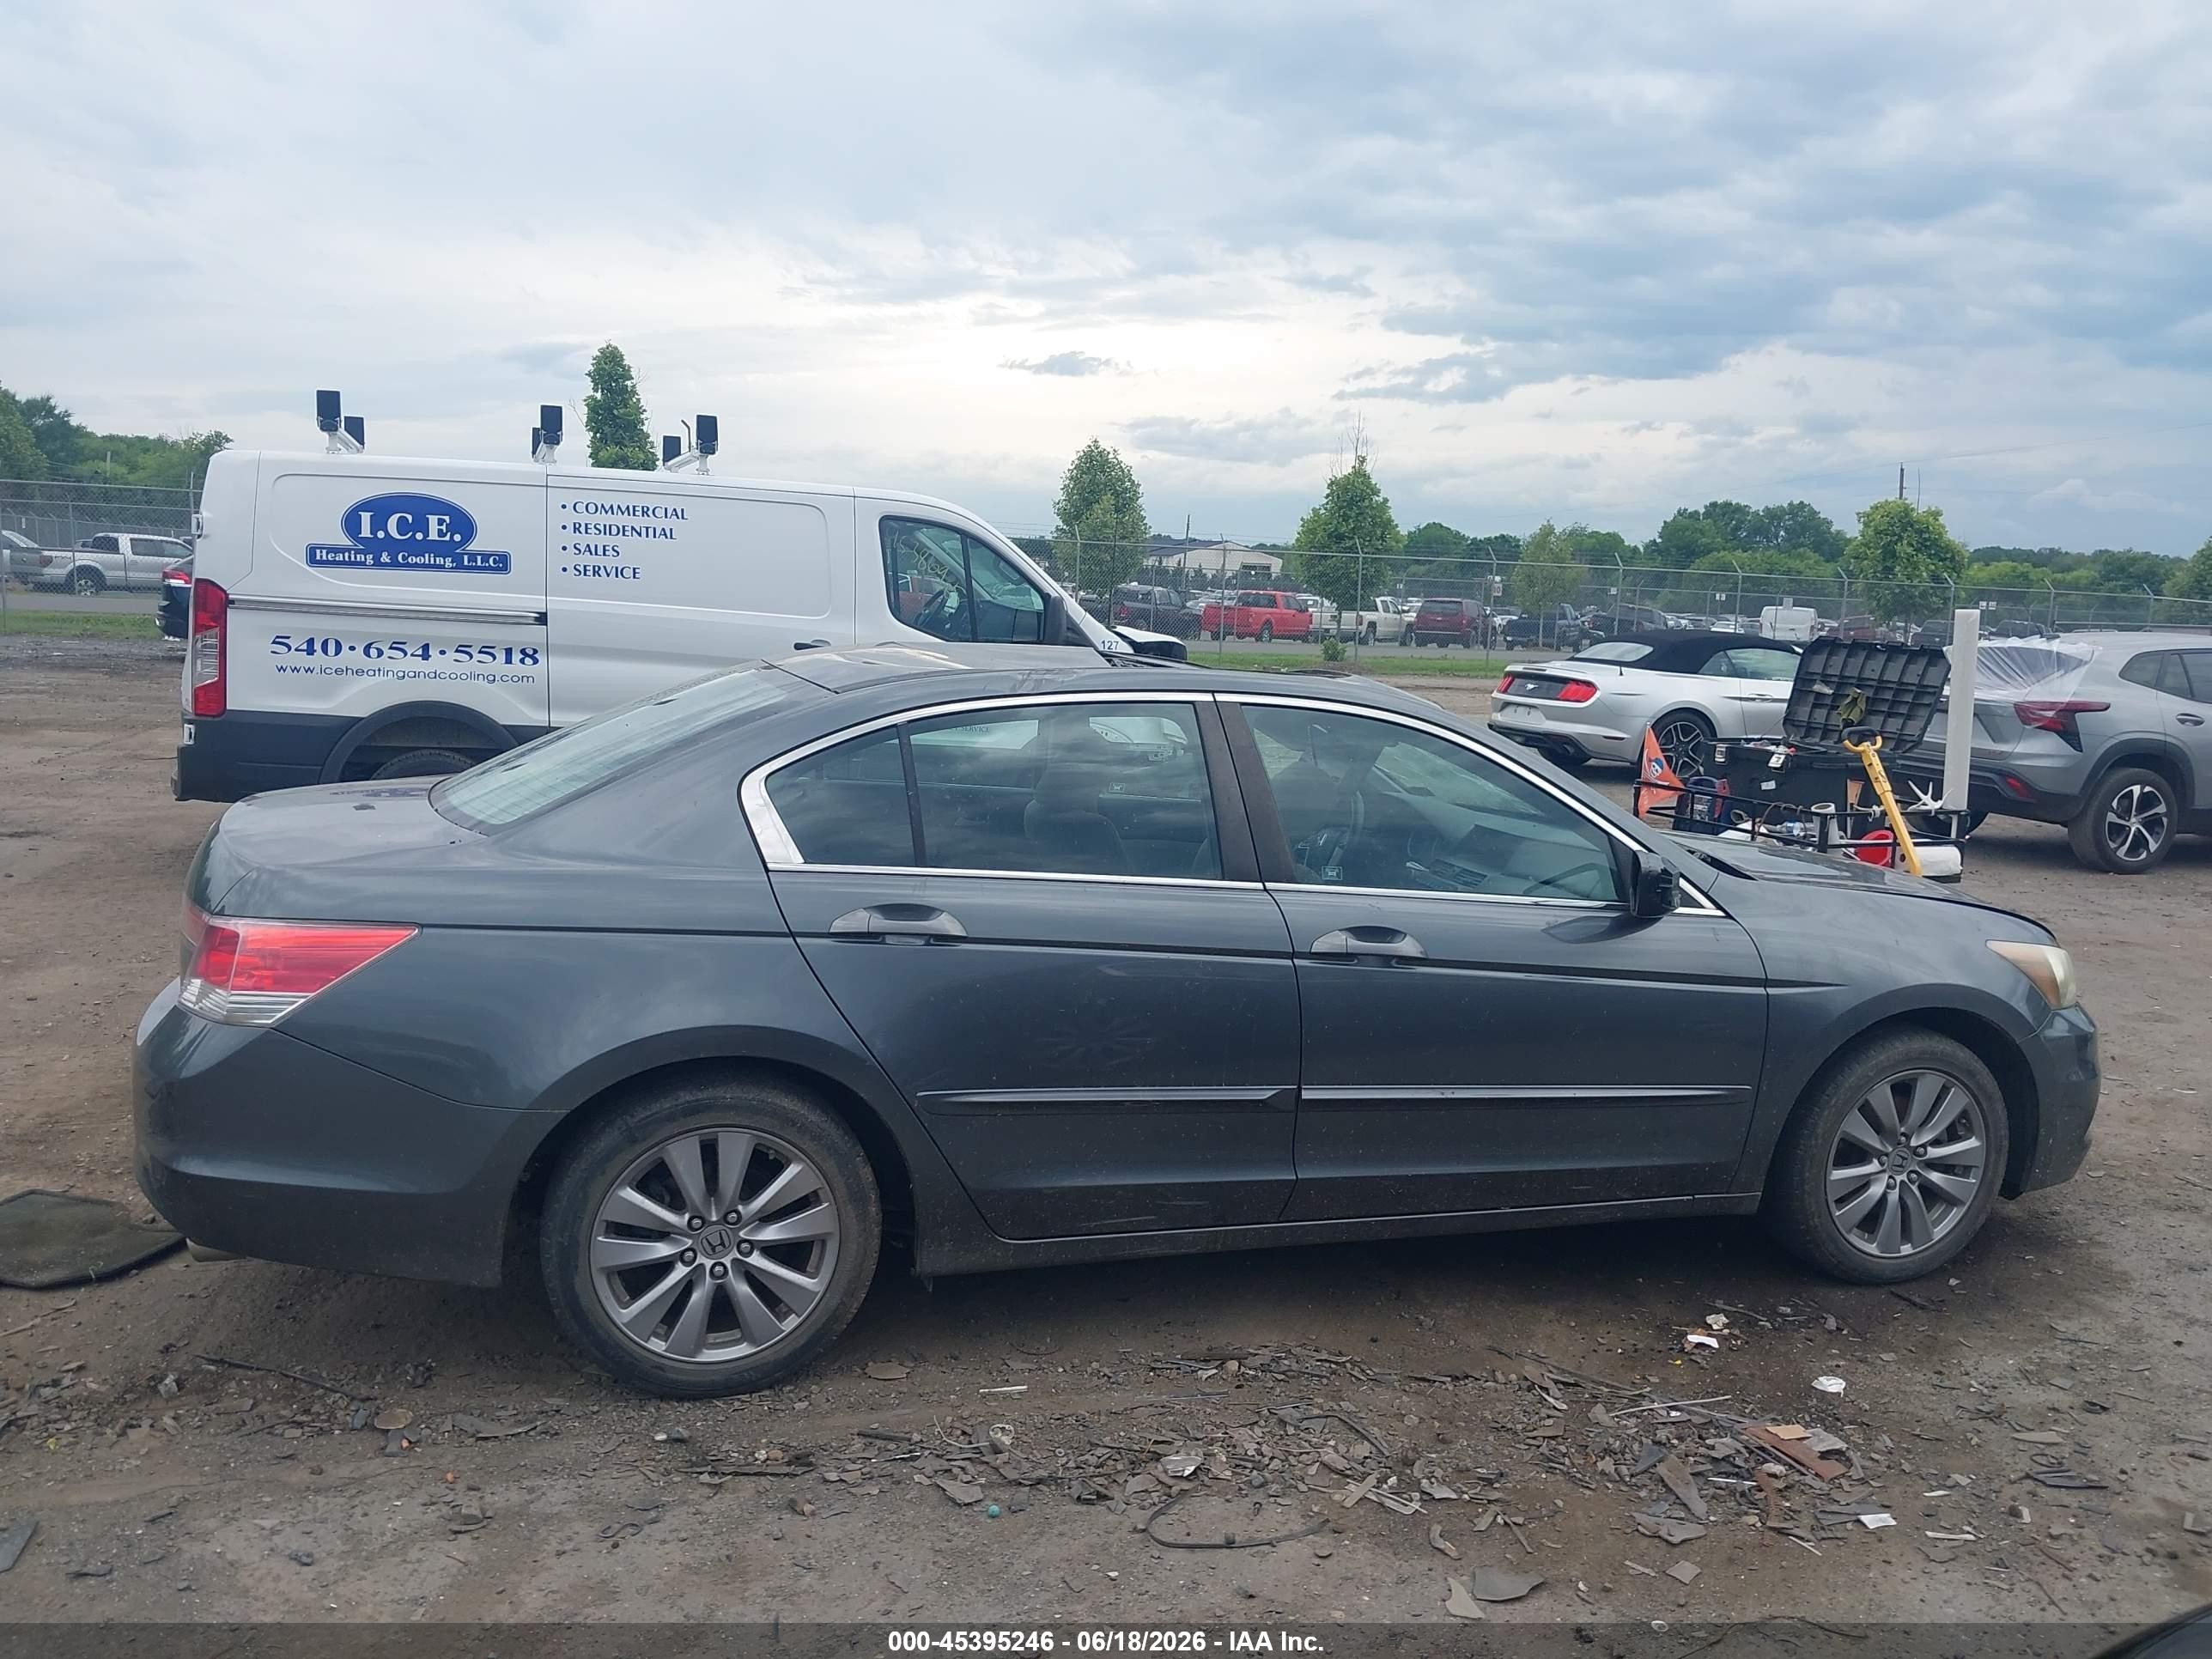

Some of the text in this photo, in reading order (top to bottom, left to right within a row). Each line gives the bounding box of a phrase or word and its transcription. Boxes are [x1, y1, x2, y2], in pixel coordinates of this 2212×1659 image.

[573, 501, 688, 520] COMMERCIAL
[358, 511, 462, 542] I.C.E.
[573, 521, 678, 540] RESIDENTIAL
[315, 549, 503, 568] Heating & Cooling, L.L.C.
[573, 543, 620, 557] SALES
[573, 563, 641, 580] SERVICE
[1101, 640, 1120, 651] 127
[275, 663, 536, 684] www.iceheatingandcooling.com
